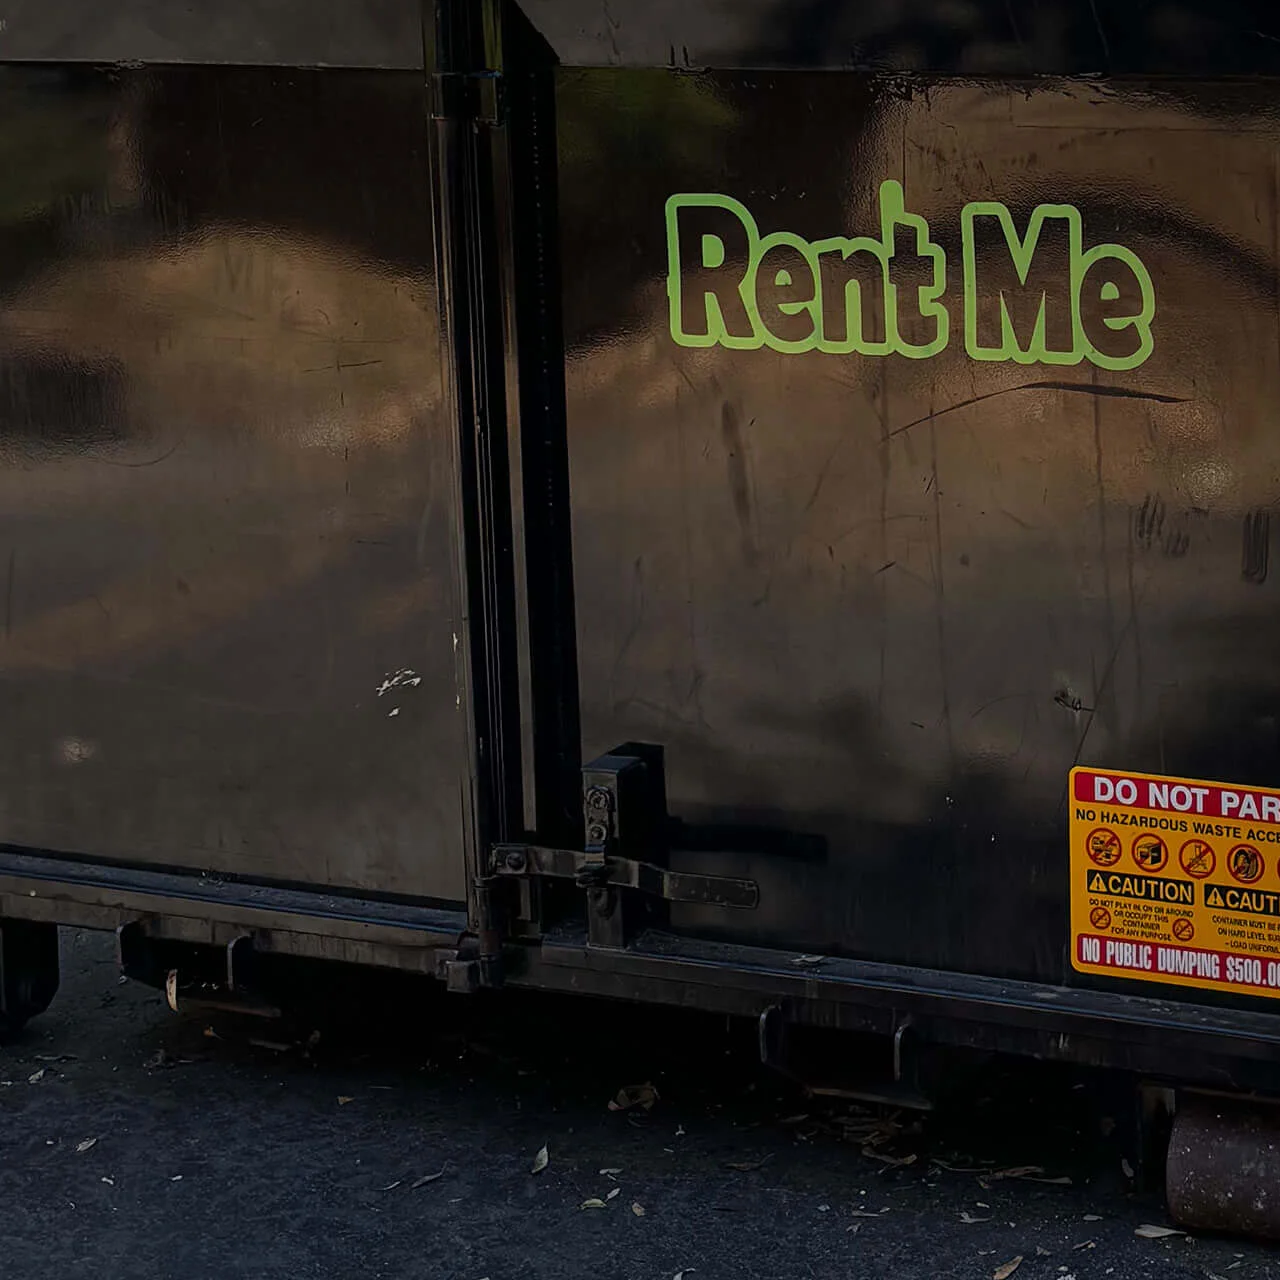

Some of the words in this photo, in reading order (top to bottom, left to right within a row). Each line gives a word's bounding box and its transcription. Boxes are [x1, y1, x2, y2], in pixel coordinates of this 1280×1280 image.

[664, 180, 950, 360] Rent
[960, 200, 1156, 371] Me
[1093, 776, 1138, 805] DO
[1148, 783, 1210, 813] NOT
[1075, 808, 1096, 822] NO
[1100, 811, 1188, 833] HAZARDOUS
[1193, 822, 1241, 839] WASTE
[1108, 875, 1192, 903] CAUTION
[1111, 926, 1125, 935] FOR
[1126, 928, 1140, 937] ANY
[1140, 930, 1172, 942] PURPOSE
[1122, 919, 1160, 930] CONTAINER
[1212, 914, 1248, 927] CONTAINER
[1249, 919, 1266, 929] MUST
[1218, 927, 1227, 936] ON
[1246, 930, 1266, 941] LEVEL
[1082, 937, 1100, 964] NO
[1106, 941, 1153, 971] PUBLIC
[1157, 948, 1220, 980] DUMPING
